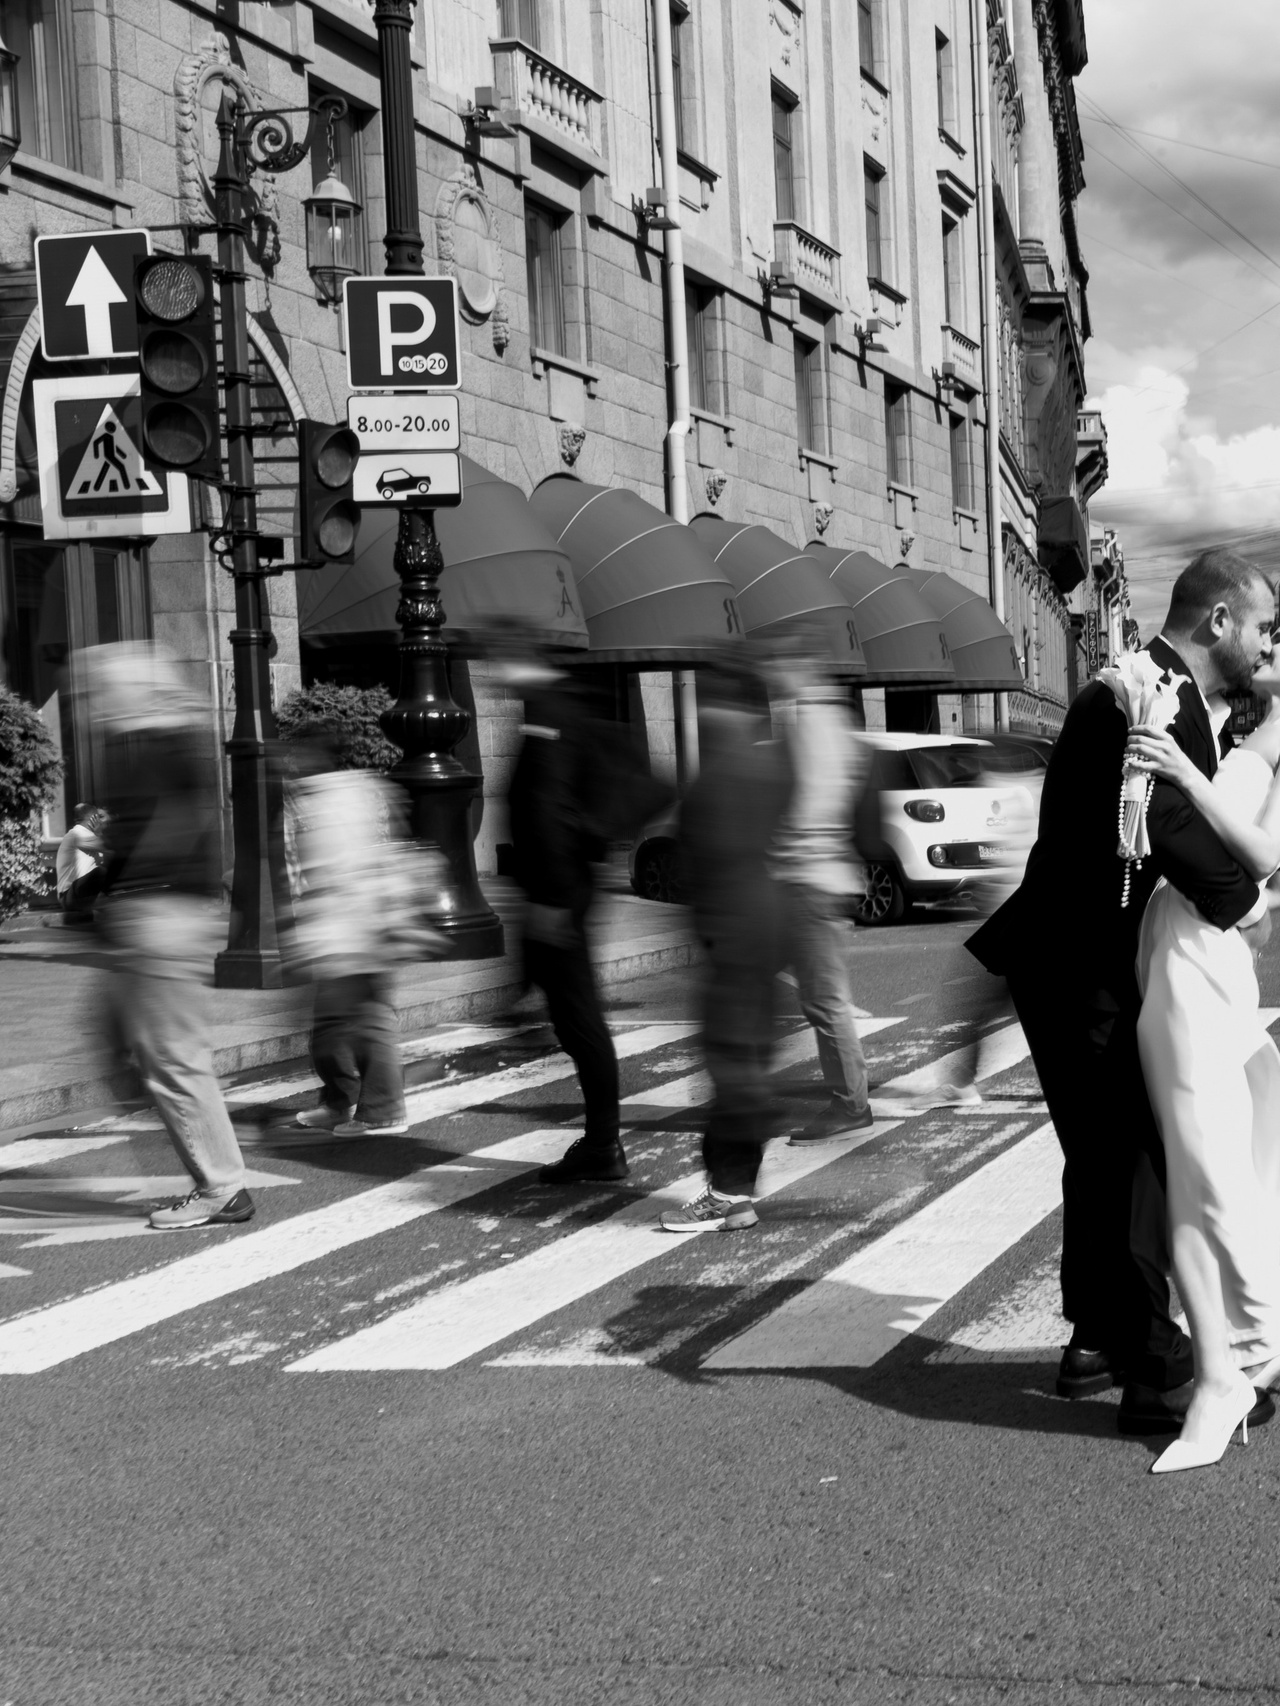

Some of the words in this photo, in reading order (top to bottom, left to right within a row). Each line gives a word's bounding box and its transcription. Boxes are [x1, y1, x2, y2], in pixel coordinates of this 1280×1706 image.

[376, 290, 437, 376] P
[402, 360, 411, 368] 10
[414, 359, 425, 369] 15
[429, 357, 446, 370] 20
[357, 415, 450, 433] 8.00-20.00
